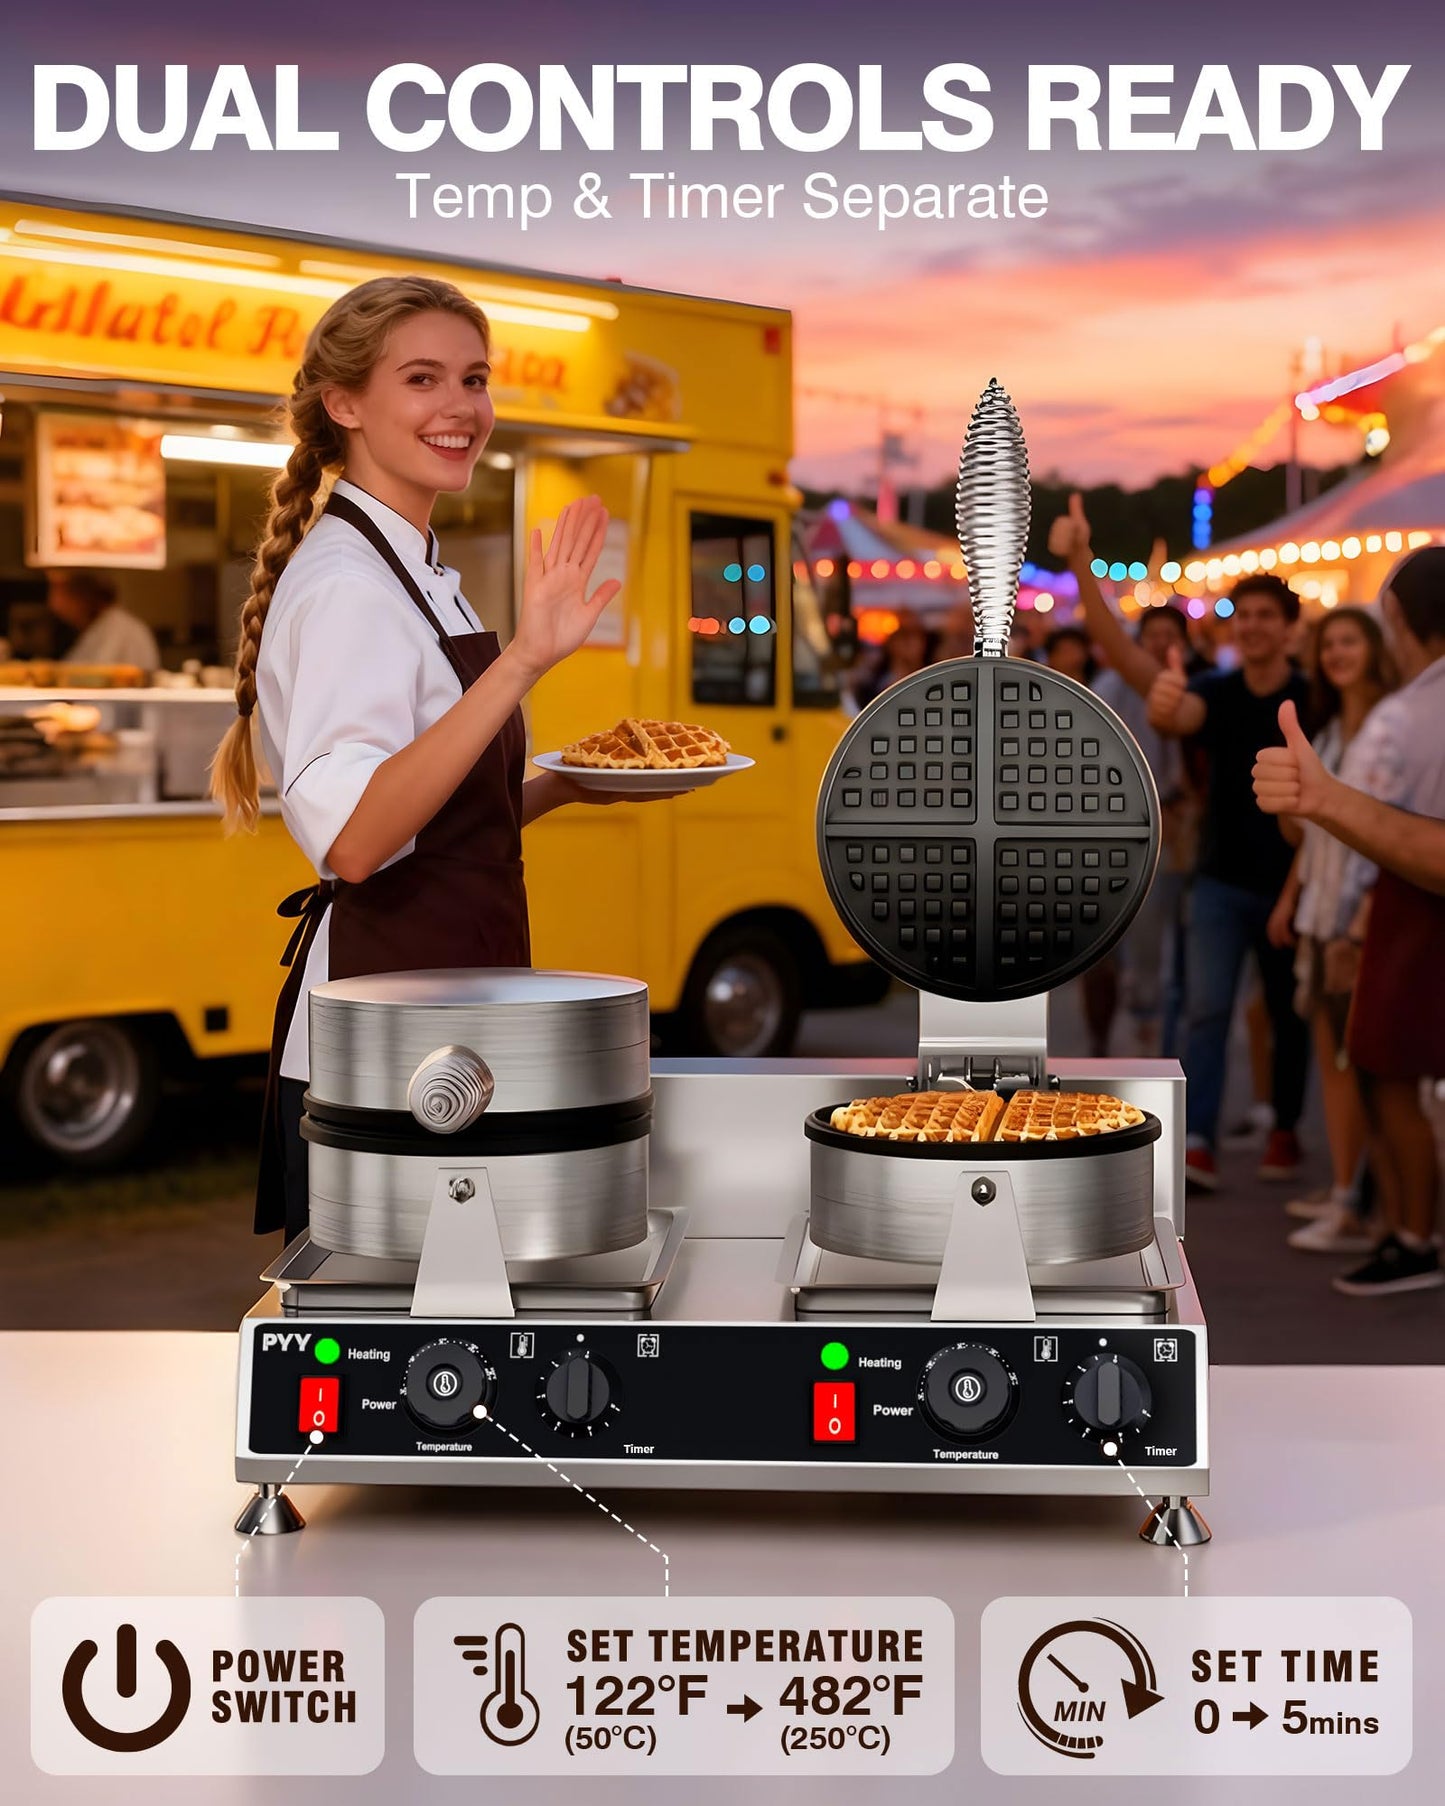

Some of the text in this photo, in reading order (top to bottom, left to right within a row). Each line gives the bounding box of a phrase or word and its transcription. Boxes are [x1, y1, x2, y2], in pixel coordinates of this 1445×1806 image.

[262, 1333, 312, 1352] PYY
[347, 1347, 391, 1363] Heating
[858, 1355, 903, 1371] Heating
[361, 1398, 397, 1410] Power
[872, 1403, 914, 1417] Power
[415, 1440, 473, 1454] Temperature
[623, 1443, 655, 1455] Timer
[1144, 1445, 1178, 1457] Timer
[932, 1448, 1000, 1461] Temperature
